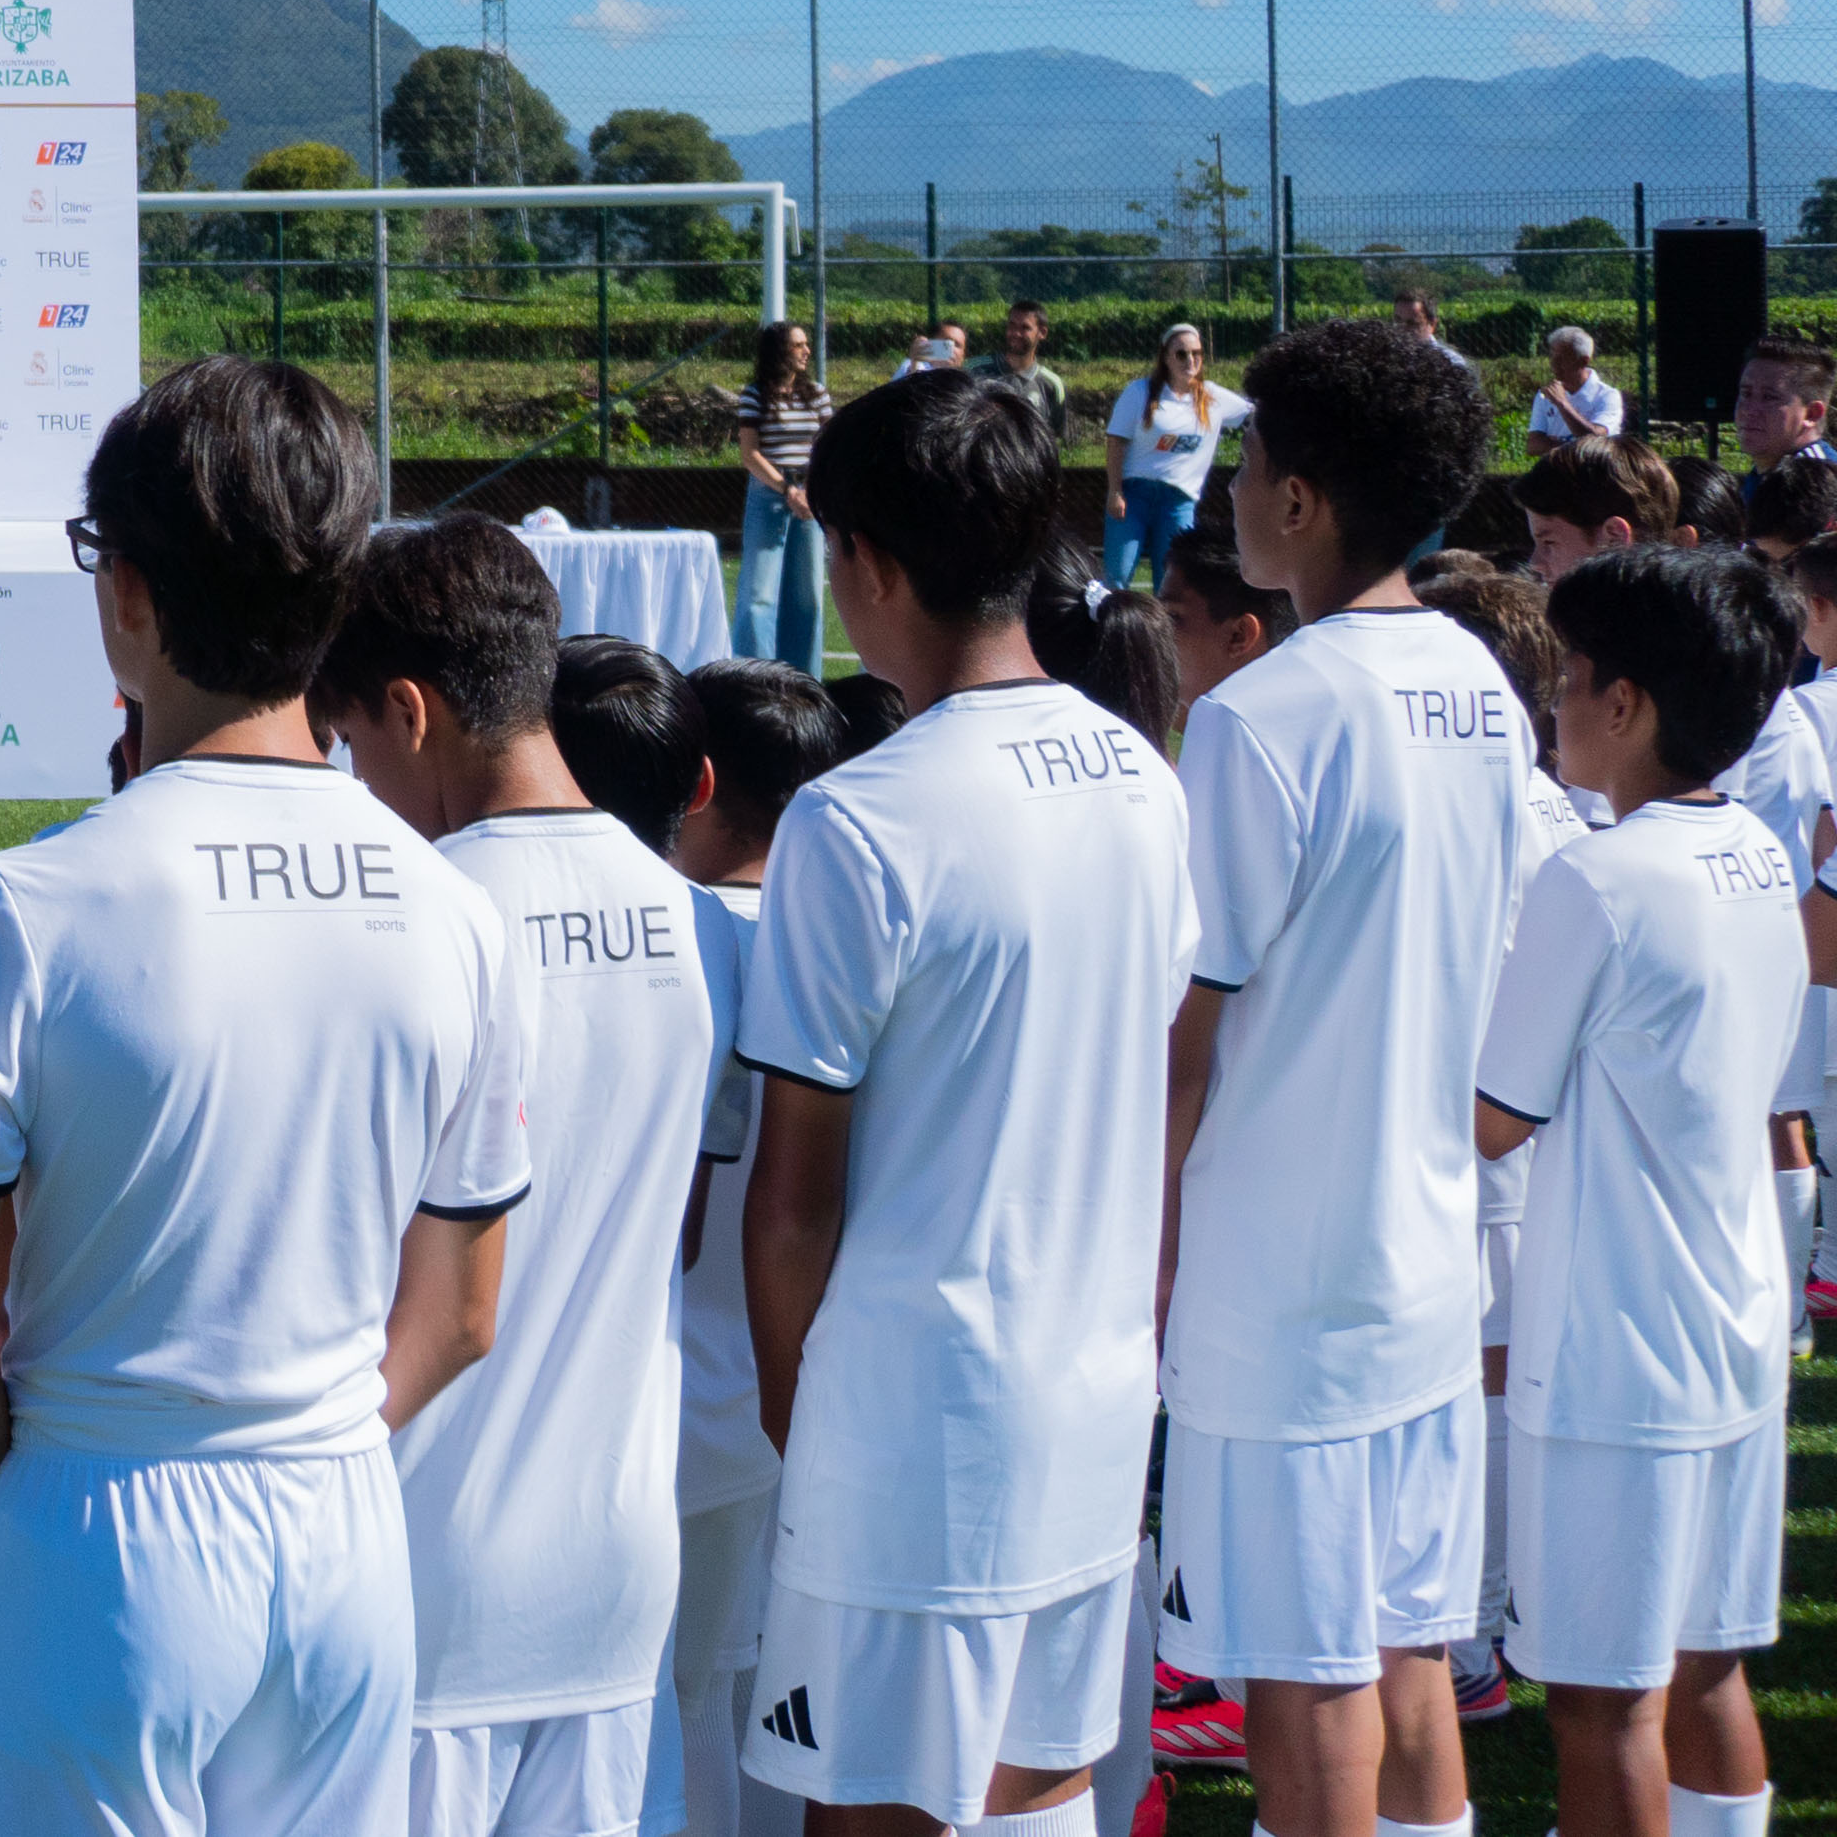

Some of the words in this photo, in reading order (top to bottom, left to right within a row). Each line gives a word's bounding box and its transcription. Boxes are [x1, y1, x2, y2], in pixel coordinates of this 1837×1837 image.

[60, 202, 92, 214] Clinic
[35, 251, 90, 268] TRUE
[61, 364, 93, 376] Clinic
[37, 414, 92, 431] TRUE
[1394, 690, 1507, 740] TRUE
[997, 729, 1140, 788] TRUE
[1530, 797, 1576, 826] TRUE
[195, 843, 401, 901] TRUE
[1694, 847, 1791, 894] TRUE
[365, 918, 407, 933] sports
[525, 905, 676, 967] TRUE
[647, 975, 682, 990] sports
